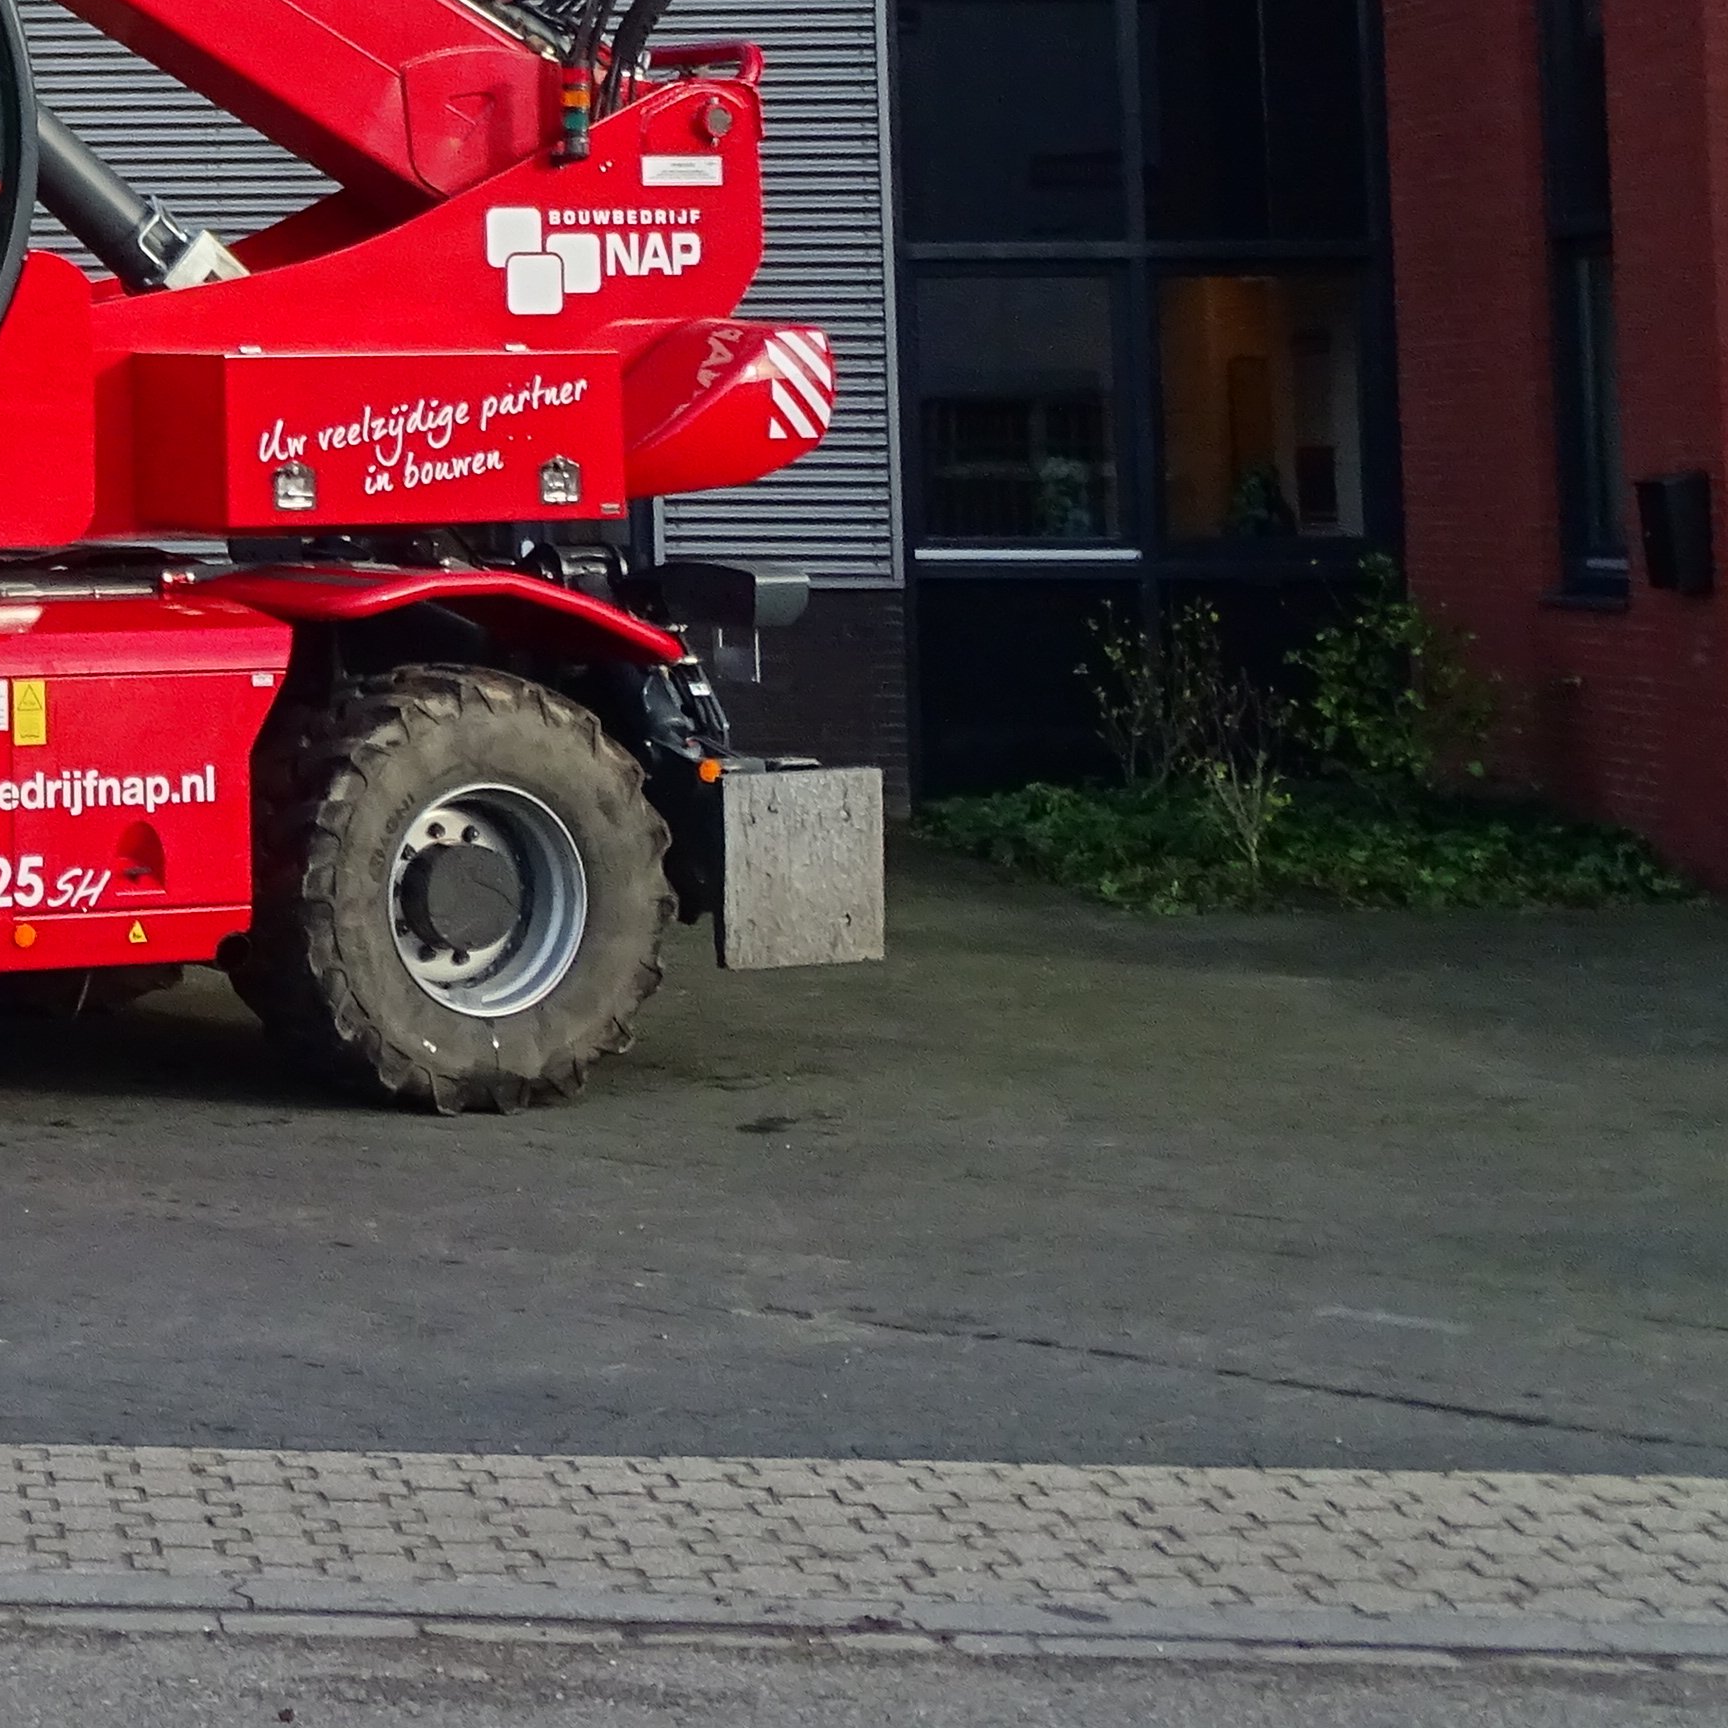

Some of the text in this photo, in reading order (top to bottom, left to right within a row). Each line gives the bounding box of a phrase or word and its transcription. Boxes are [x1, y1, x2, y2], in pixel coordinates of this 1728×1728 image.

[548, 208, 701, 225] BOUWBEDRIJF
[605, 231, 702, 276] NAP
[258, 418, 307, 462] Uw
[480, 374, 588, 432] partner
[364, 450, 504, 495] in bouwen
[47, 867, 112, 908] SH
